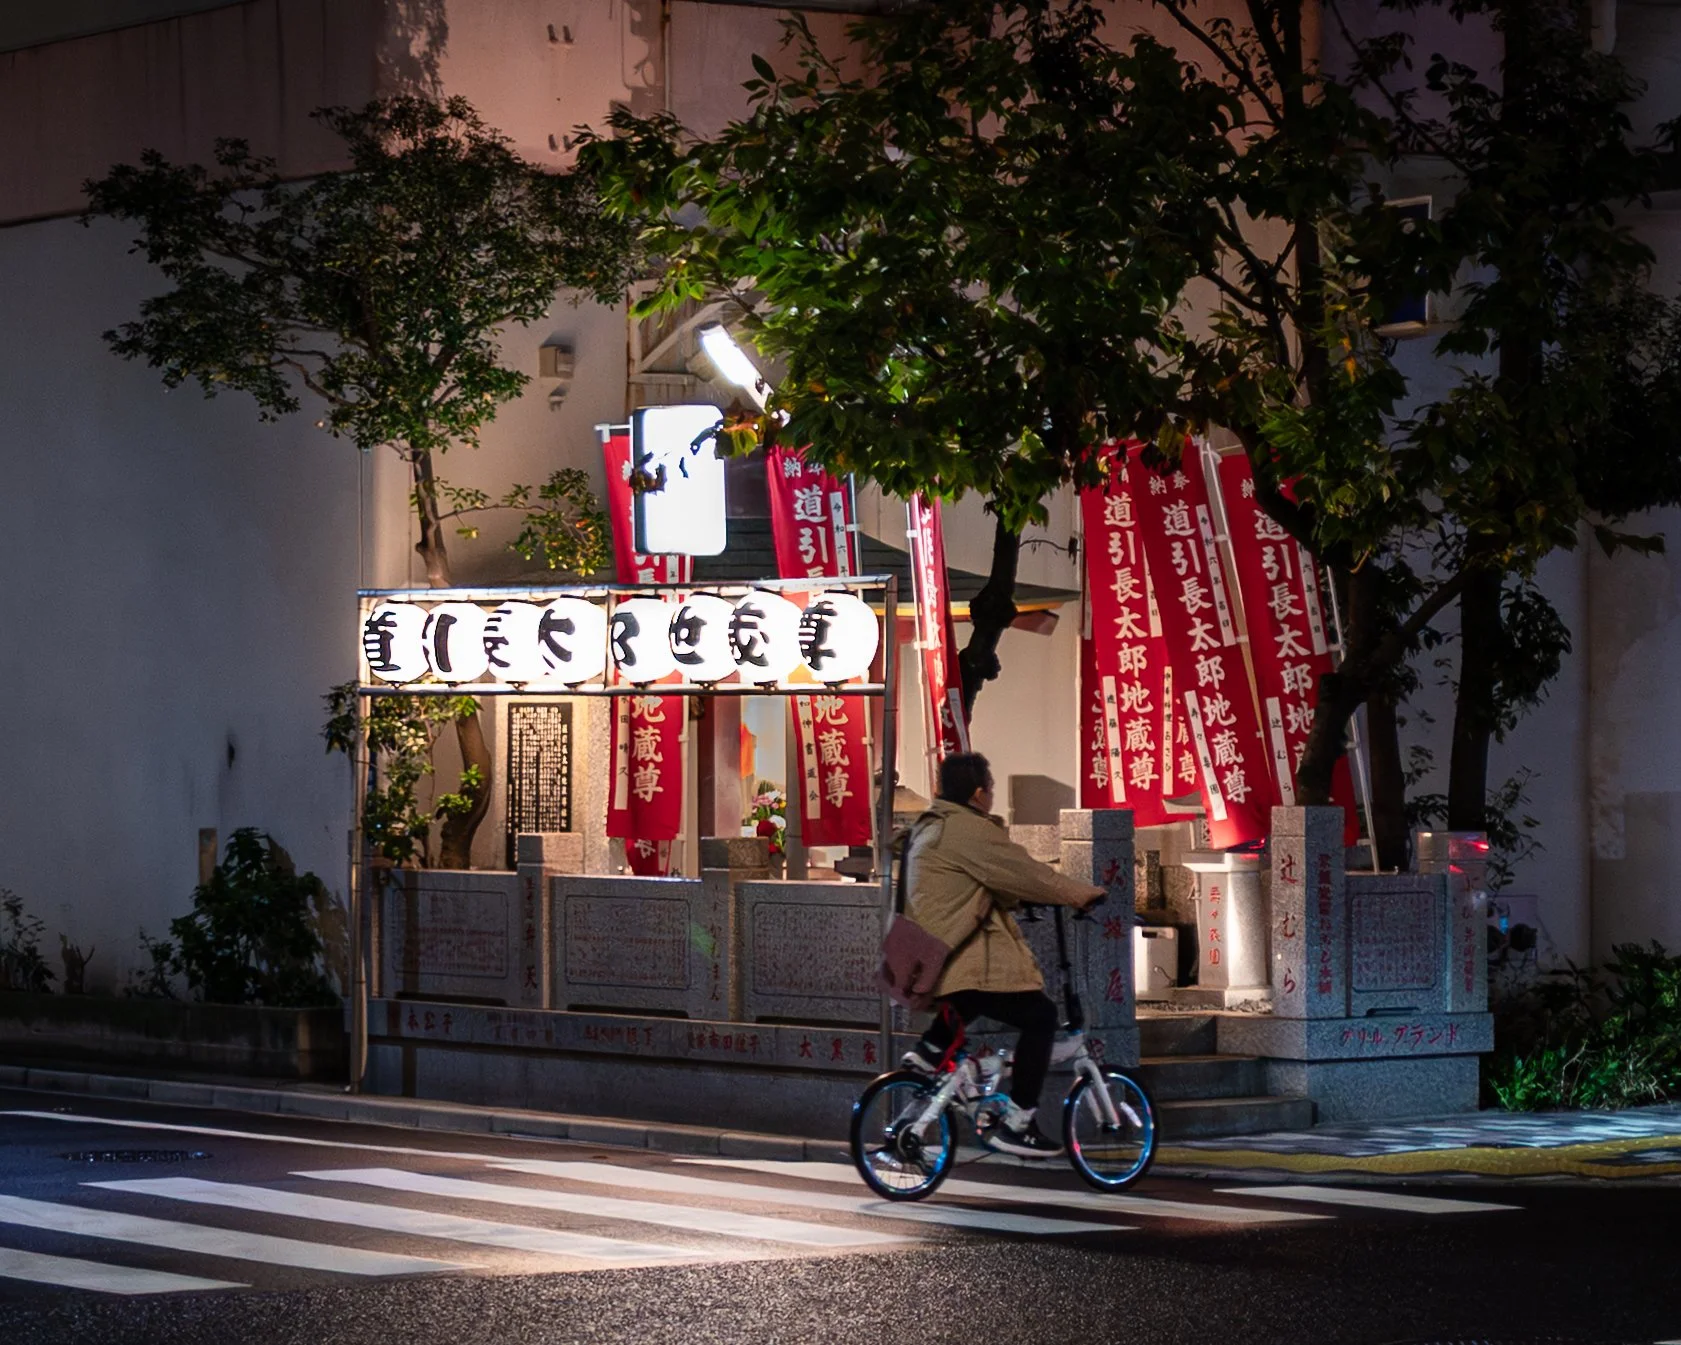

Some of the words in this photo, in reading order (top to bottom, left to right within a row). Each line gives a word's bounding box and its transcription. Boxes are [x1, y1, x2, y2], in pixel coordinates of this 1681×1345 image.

[1103, 492, 1160, 791] 道引長太郎地蔵尊
[1162, 499, 1253, 804] 道引長太郎地蔵尊
[1280, 854, 1298, 994] 辻むら
